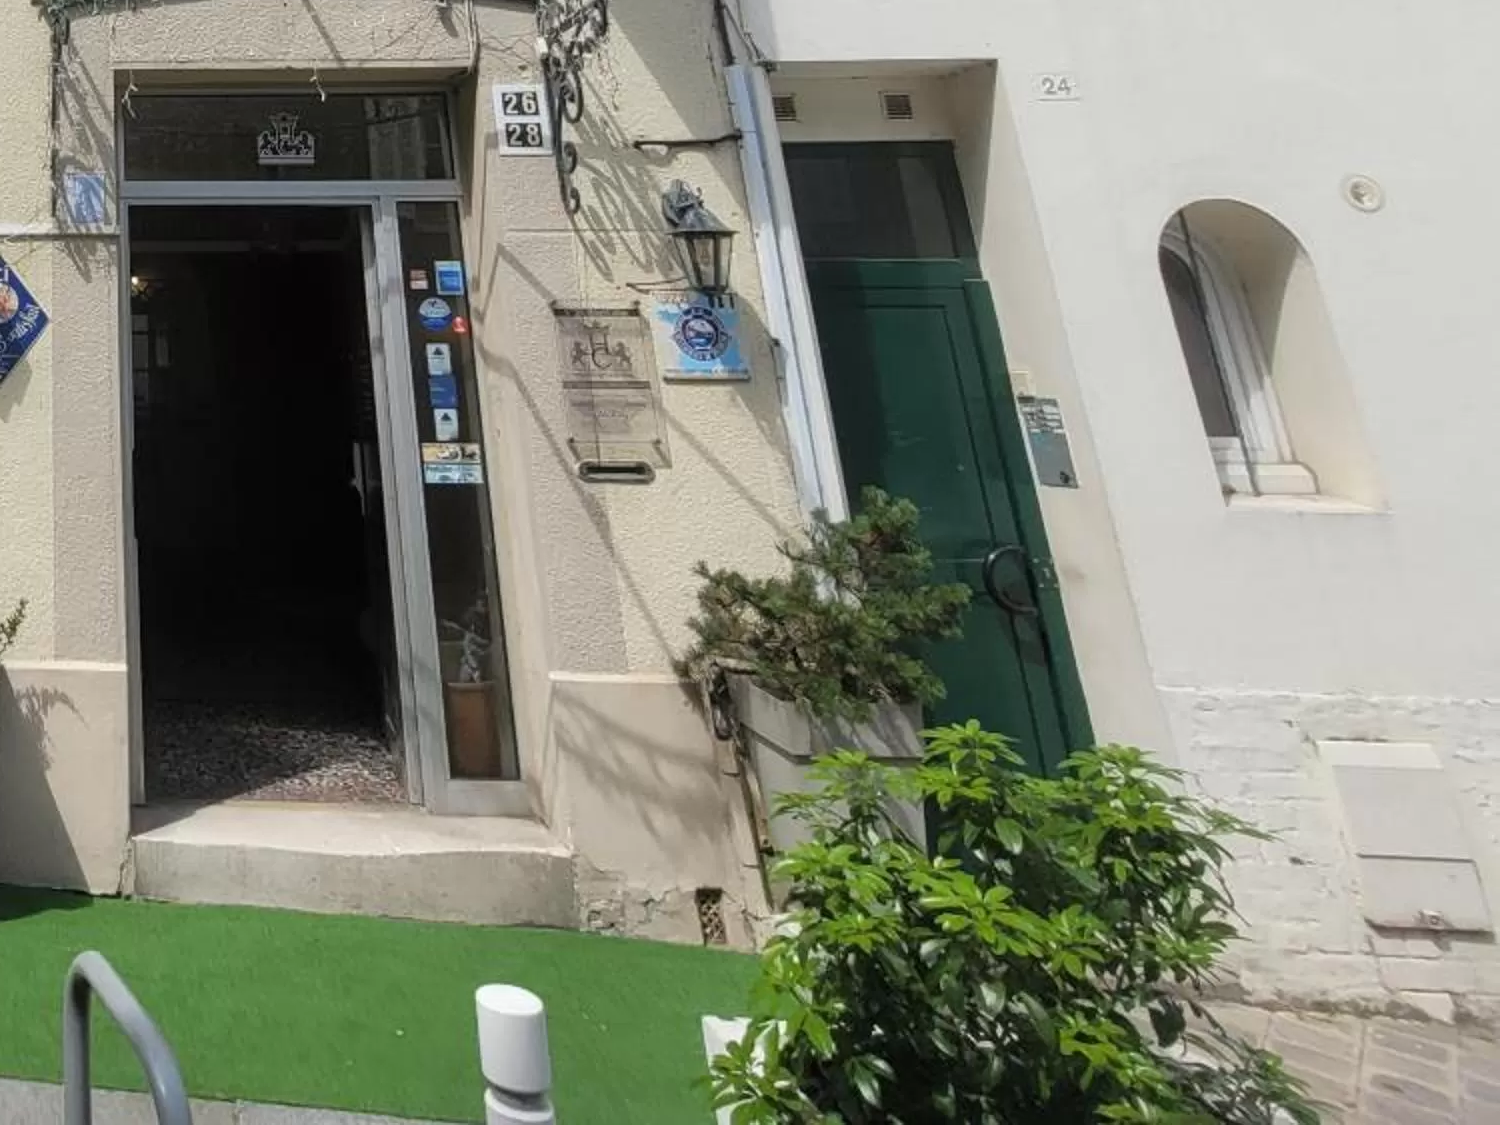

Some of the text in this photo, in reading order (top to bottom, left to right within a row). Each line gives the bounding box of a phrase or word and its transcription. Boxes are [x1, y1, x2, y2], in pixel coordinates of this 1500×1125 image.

[1041, 77, 1071, 96] 24
[503, 92, 537, 115] 26
[507, 123, 541, 147] 28
